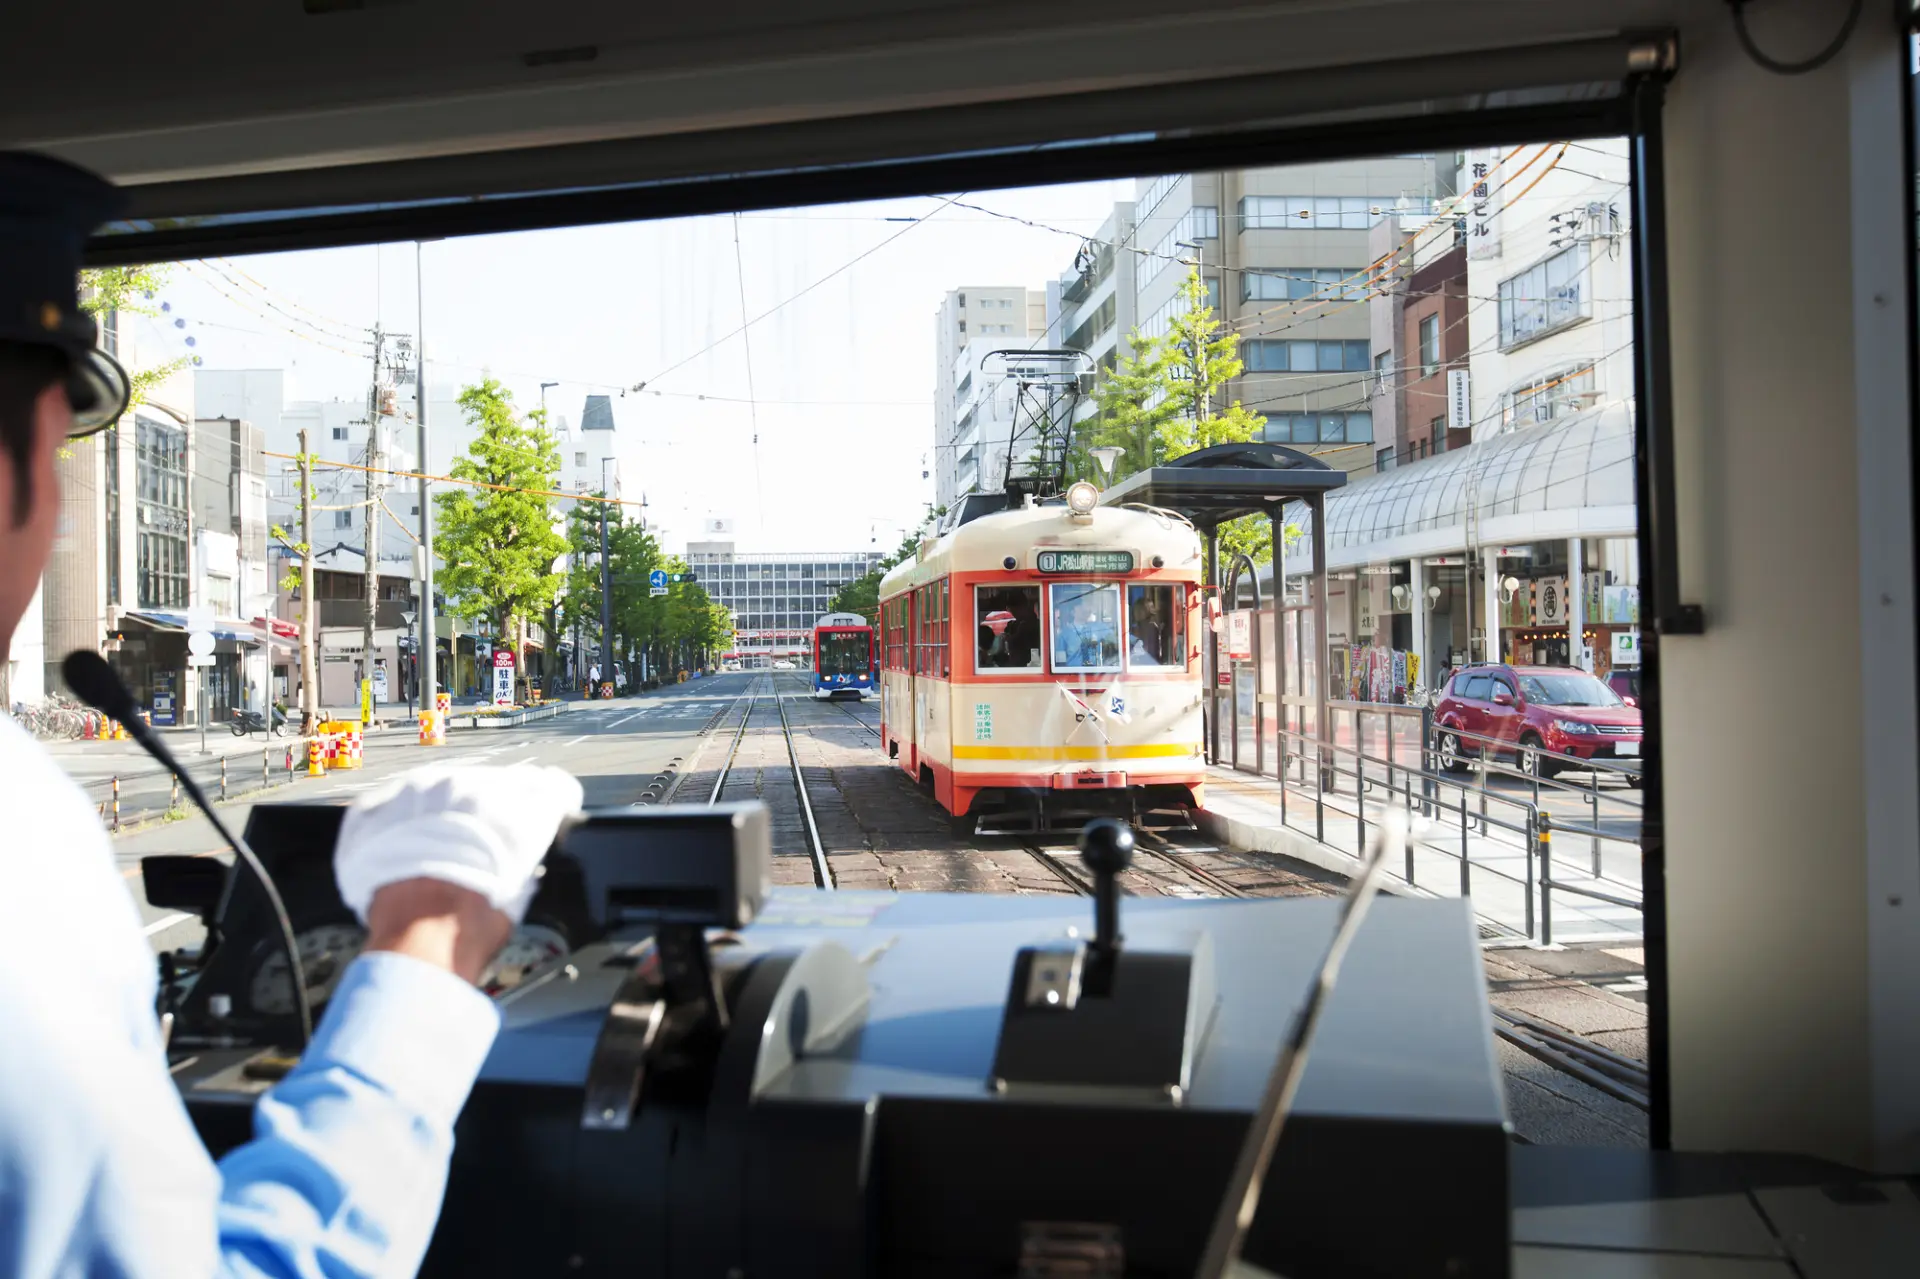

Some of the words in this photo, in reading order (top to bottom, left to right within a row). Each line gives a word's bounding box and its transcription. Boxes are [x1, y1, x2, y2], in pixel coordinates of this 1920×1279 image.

[1472, 162, 1490, 237] 花園ビル
[499, 669, 509, 690] 駐車
[496, 690, 512, 698] OK!
